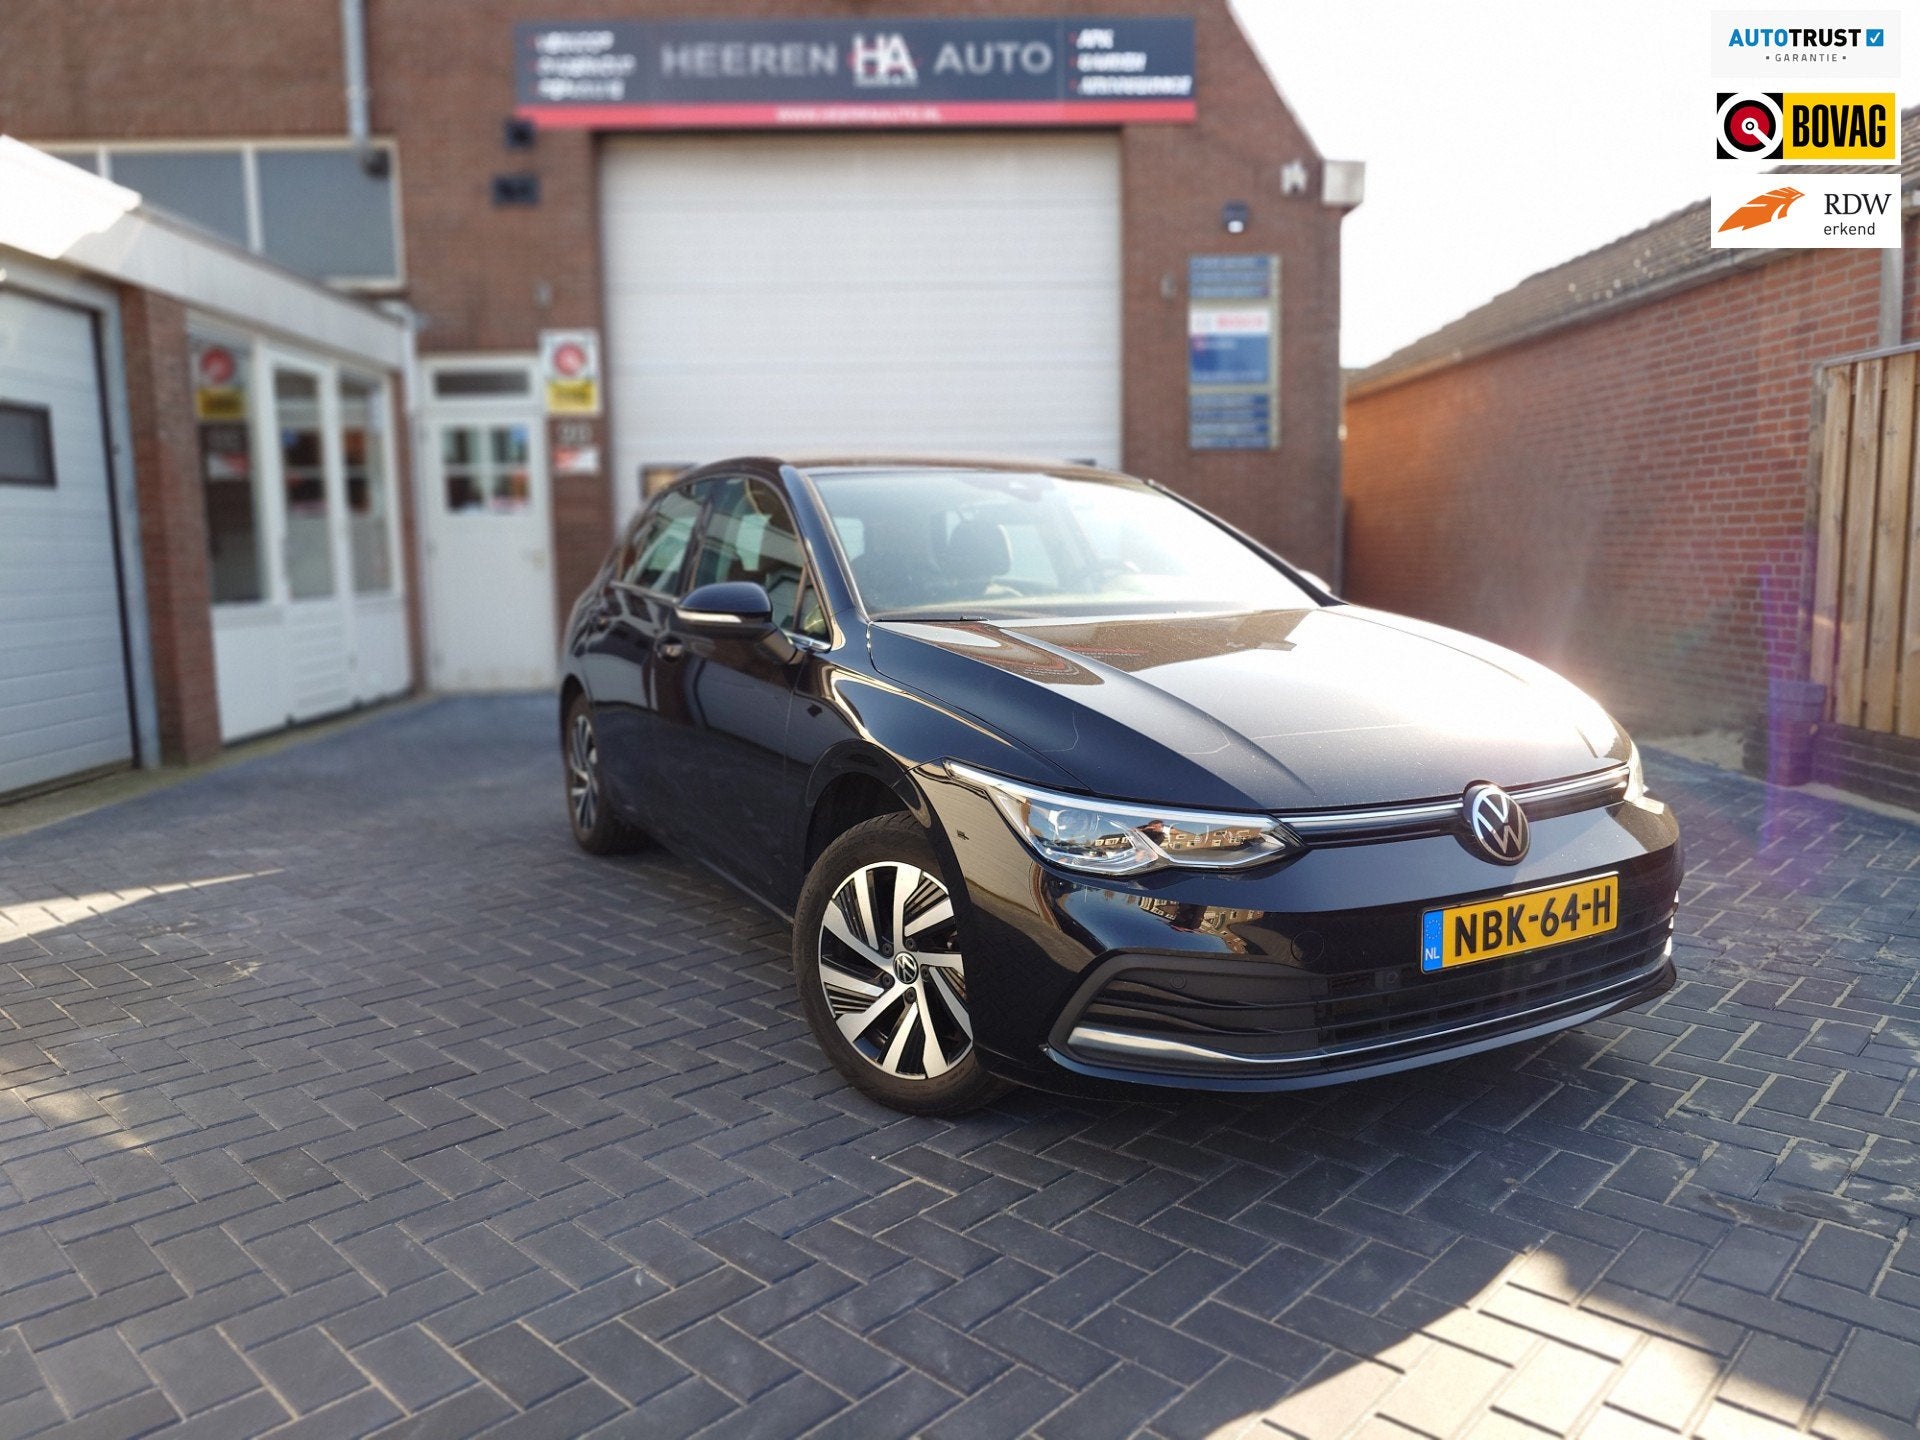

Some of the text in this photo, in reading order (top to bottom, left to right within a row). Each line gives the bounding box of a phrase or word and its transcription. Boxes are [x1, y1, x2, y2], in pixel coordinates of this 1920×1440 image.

[660, 42, 838, 77] HEEREN
[852, 33, 918, 81] HA
[934, 42, 1054, 75] AUTO
[1455, 884, 1611, 957] NBK-64-H
[1424, 947, 1441, 960] NL
